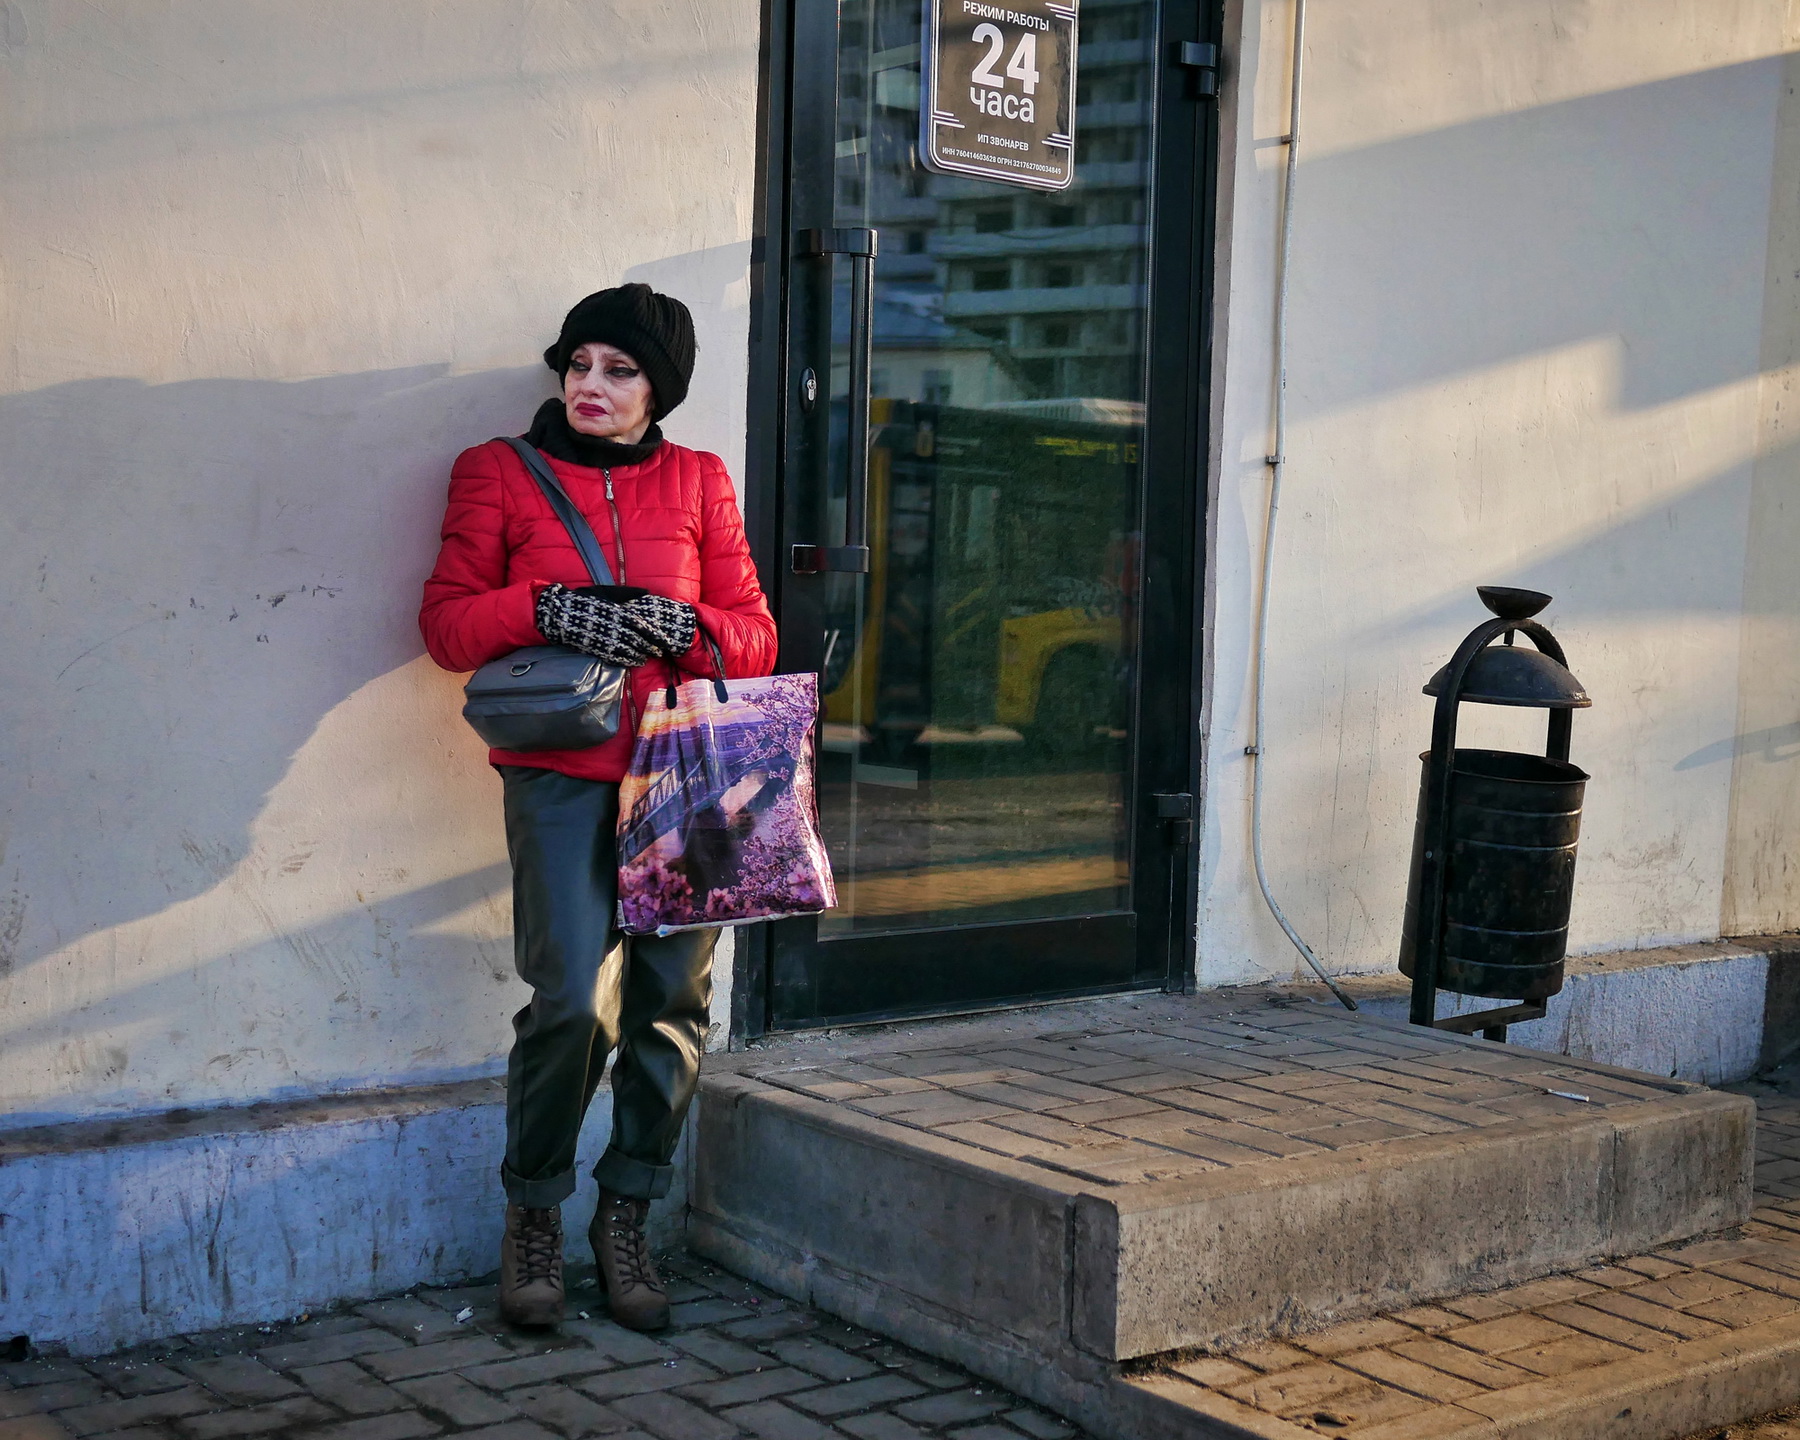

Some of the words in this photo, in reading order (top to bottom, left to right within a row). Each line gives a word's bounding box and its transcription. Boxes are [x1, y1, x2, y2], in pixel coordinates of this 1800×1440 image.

[963, 0, 1004, 21] РЕЖИМ
[1007, 12, 1050, 31] РАБОТЫ
[971, 22, 1040, 95] 24
[969, 87, 1035, 123] часа
[942, 146, 956, 156] ИНН
[956, 148, 997, 163] 760414603628
[997, 156, 1013, 166] ОГРН
[977, 133, 989, 144] ИП
[990, 135, 1029, 151] ЗВОНАРЕВ
